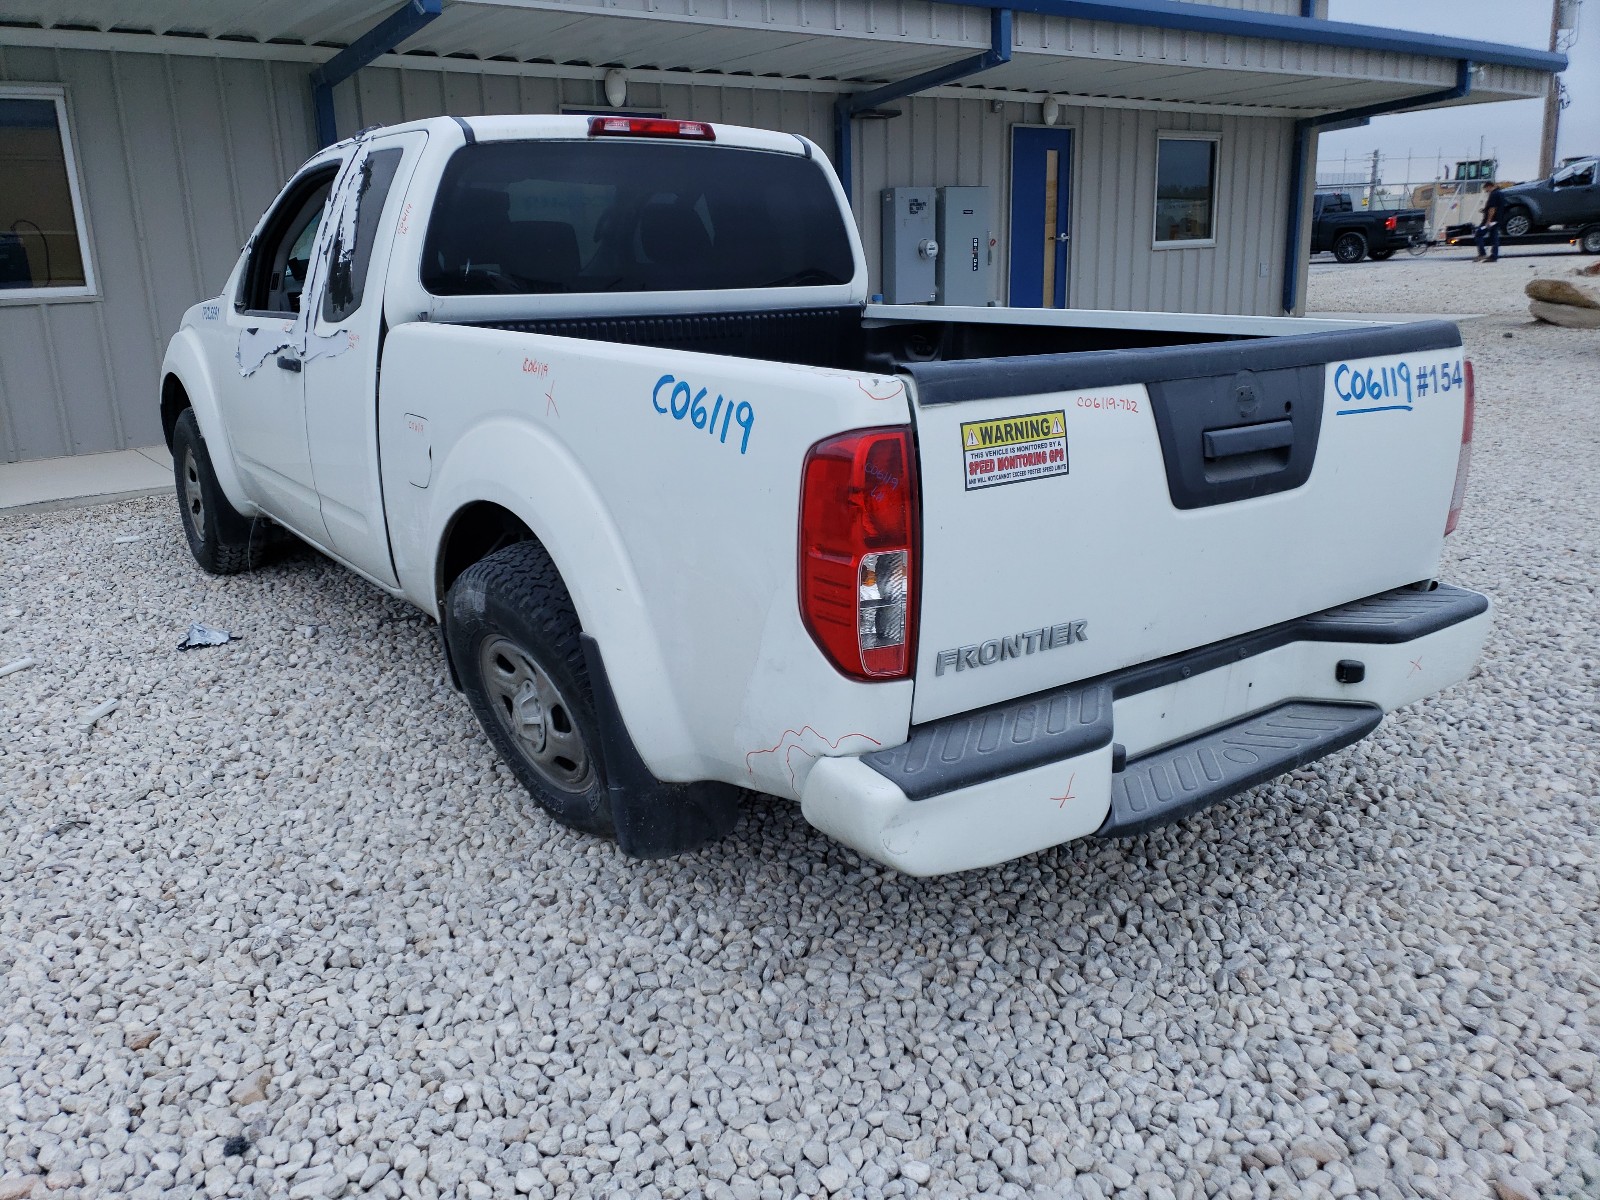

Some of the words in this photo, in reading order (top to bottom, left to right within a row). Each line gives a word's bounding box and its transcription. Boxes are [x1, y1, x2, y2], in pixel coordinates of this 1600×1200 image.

[1416, 361, 1463, 398] #154
[979, 417, 1050, 446] WARNING
[968, 459, 996, 476] SPEED
[997, 450, 1048, 472] MONITORING
[1048, 447, 1065, 463] GPS
[970, 451, 984, 460] THIS
[985, 448, 1009, 458] VEHICLE
[1009, 446, 1016, 454] IS
[1016, 442, 1048, 453] MONITORED
[1042, 465, 1054, 473] SPEED
[935, 618, 1089, 677] FRONTIER
